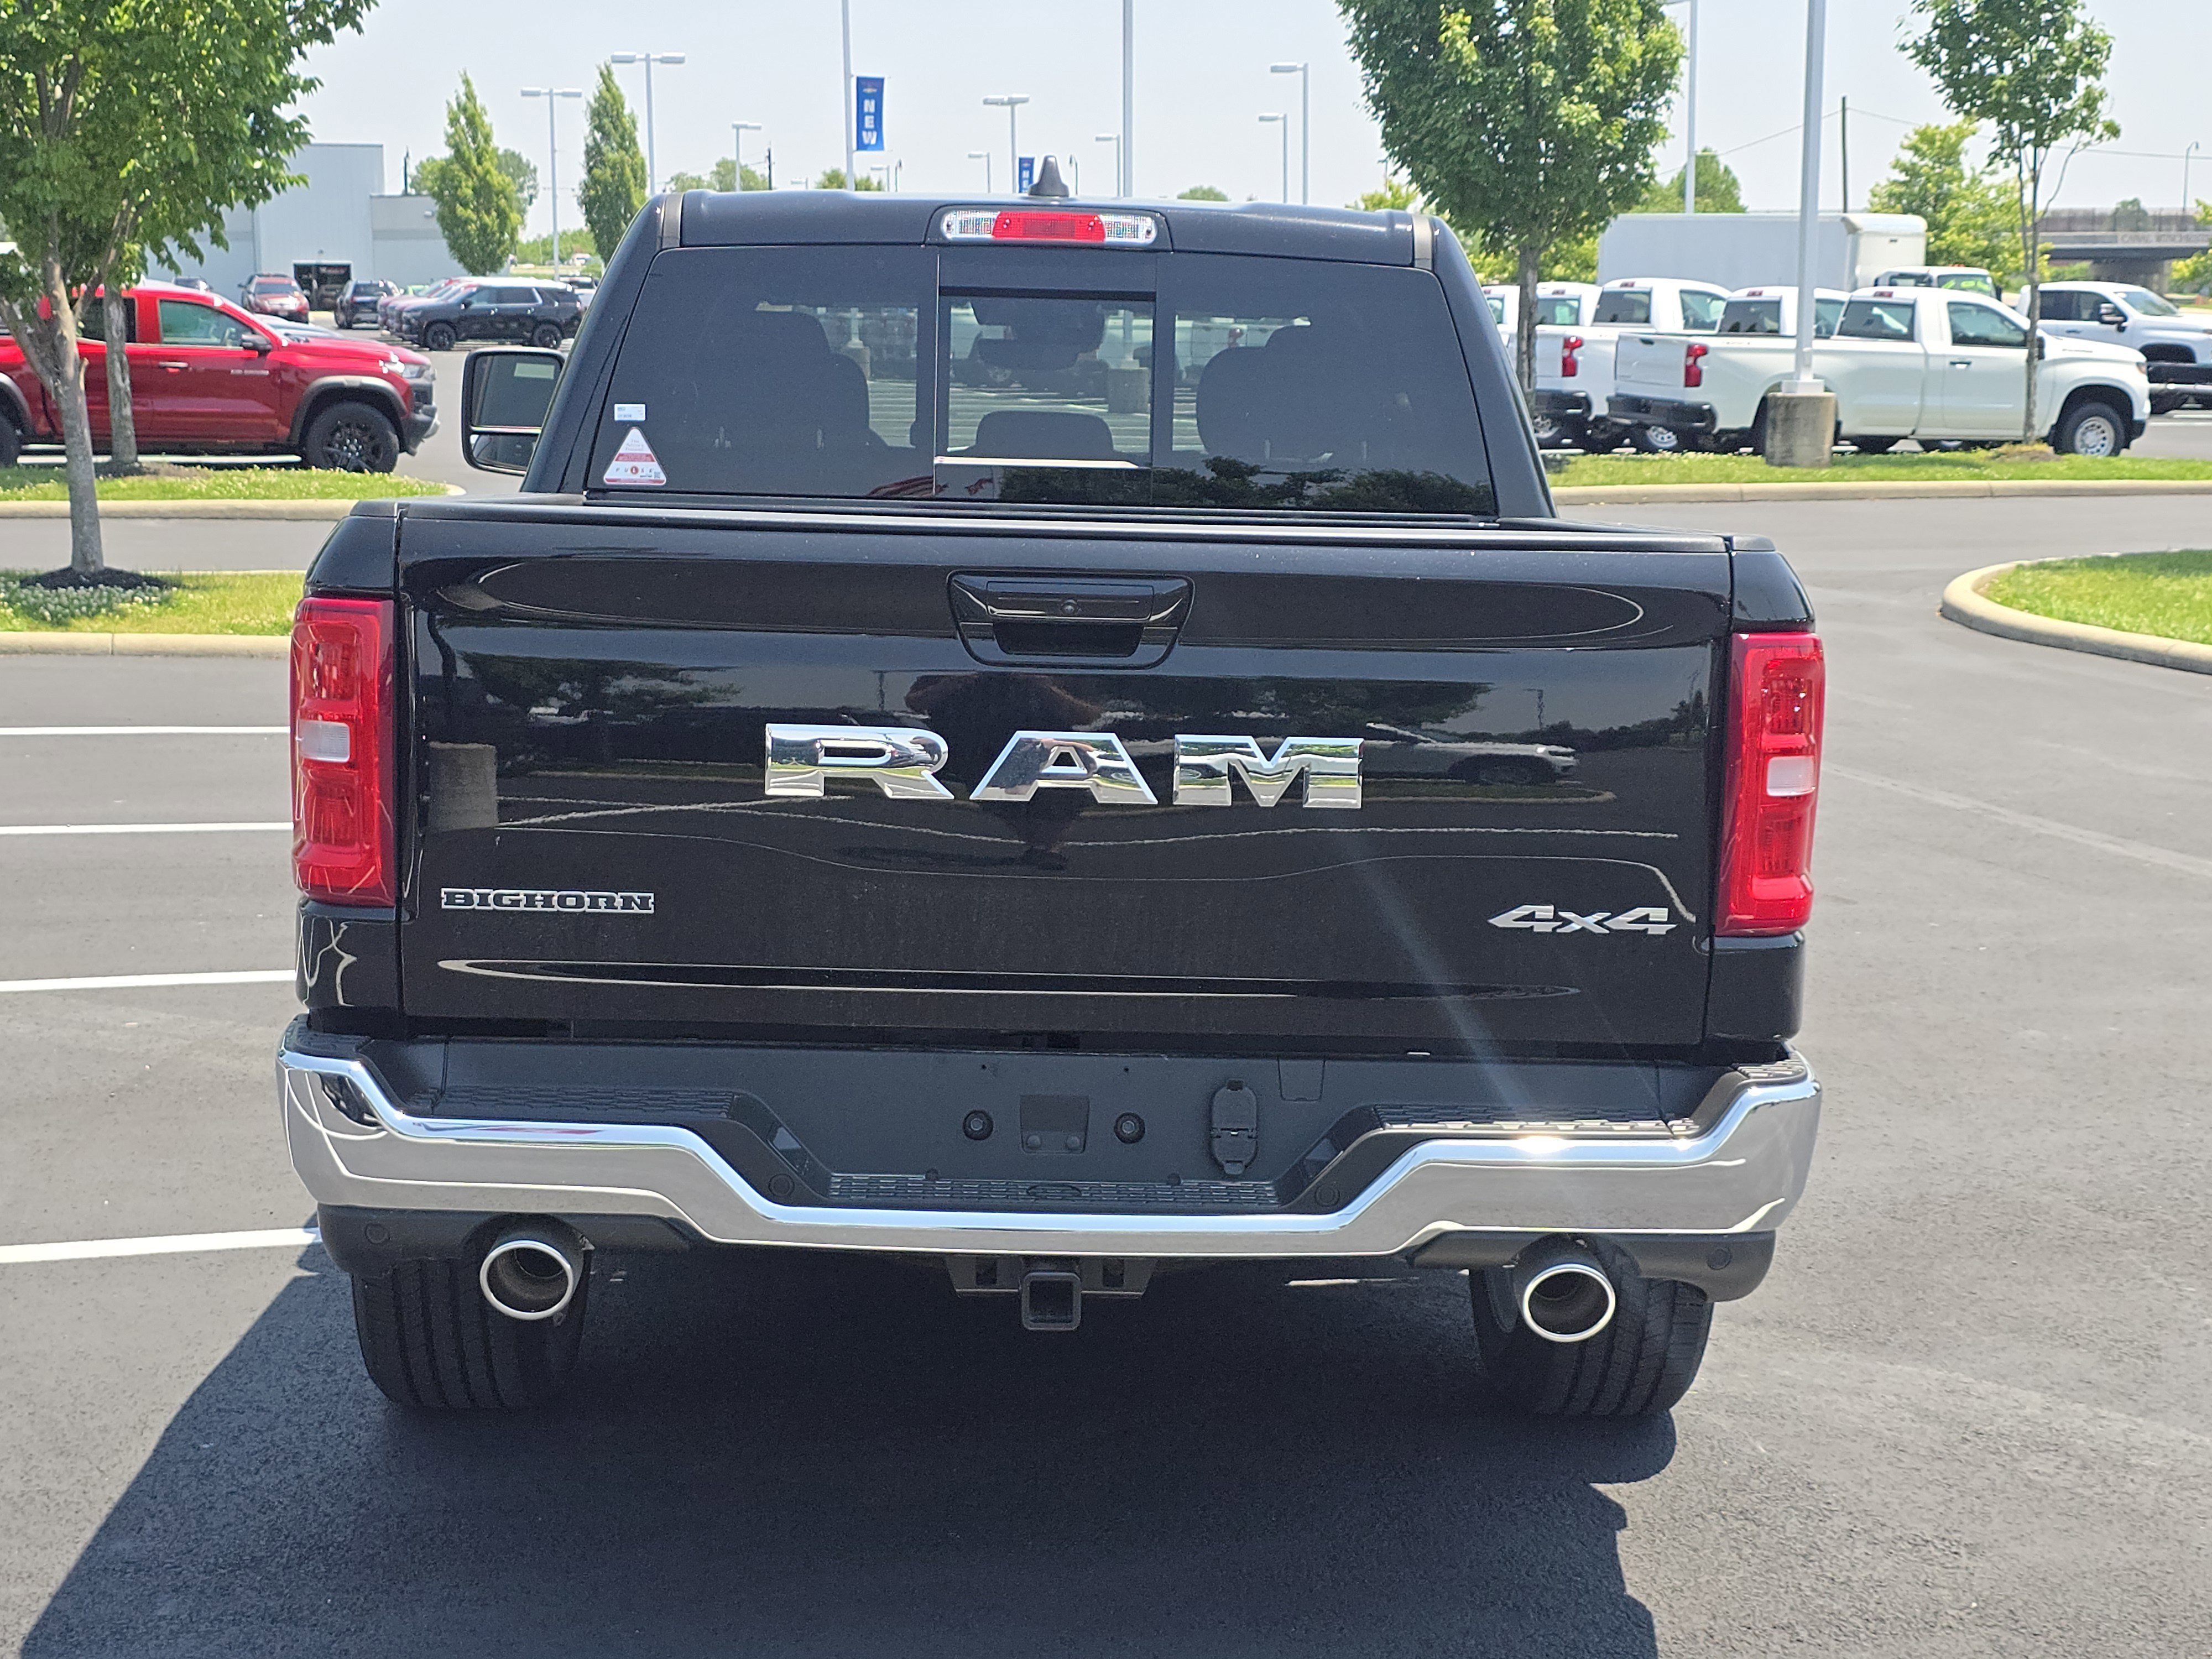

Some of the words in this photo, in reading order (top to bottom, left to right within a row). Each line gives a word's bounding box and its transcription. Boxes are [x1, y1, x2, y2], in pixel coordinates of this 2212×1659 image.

[862, 99, 877, 145] NEW
[765, 723, 1364, 809] RAM
[441, 888, 655, 914] BIGHORN
[1487, 904, 1678, 935] 4x4
